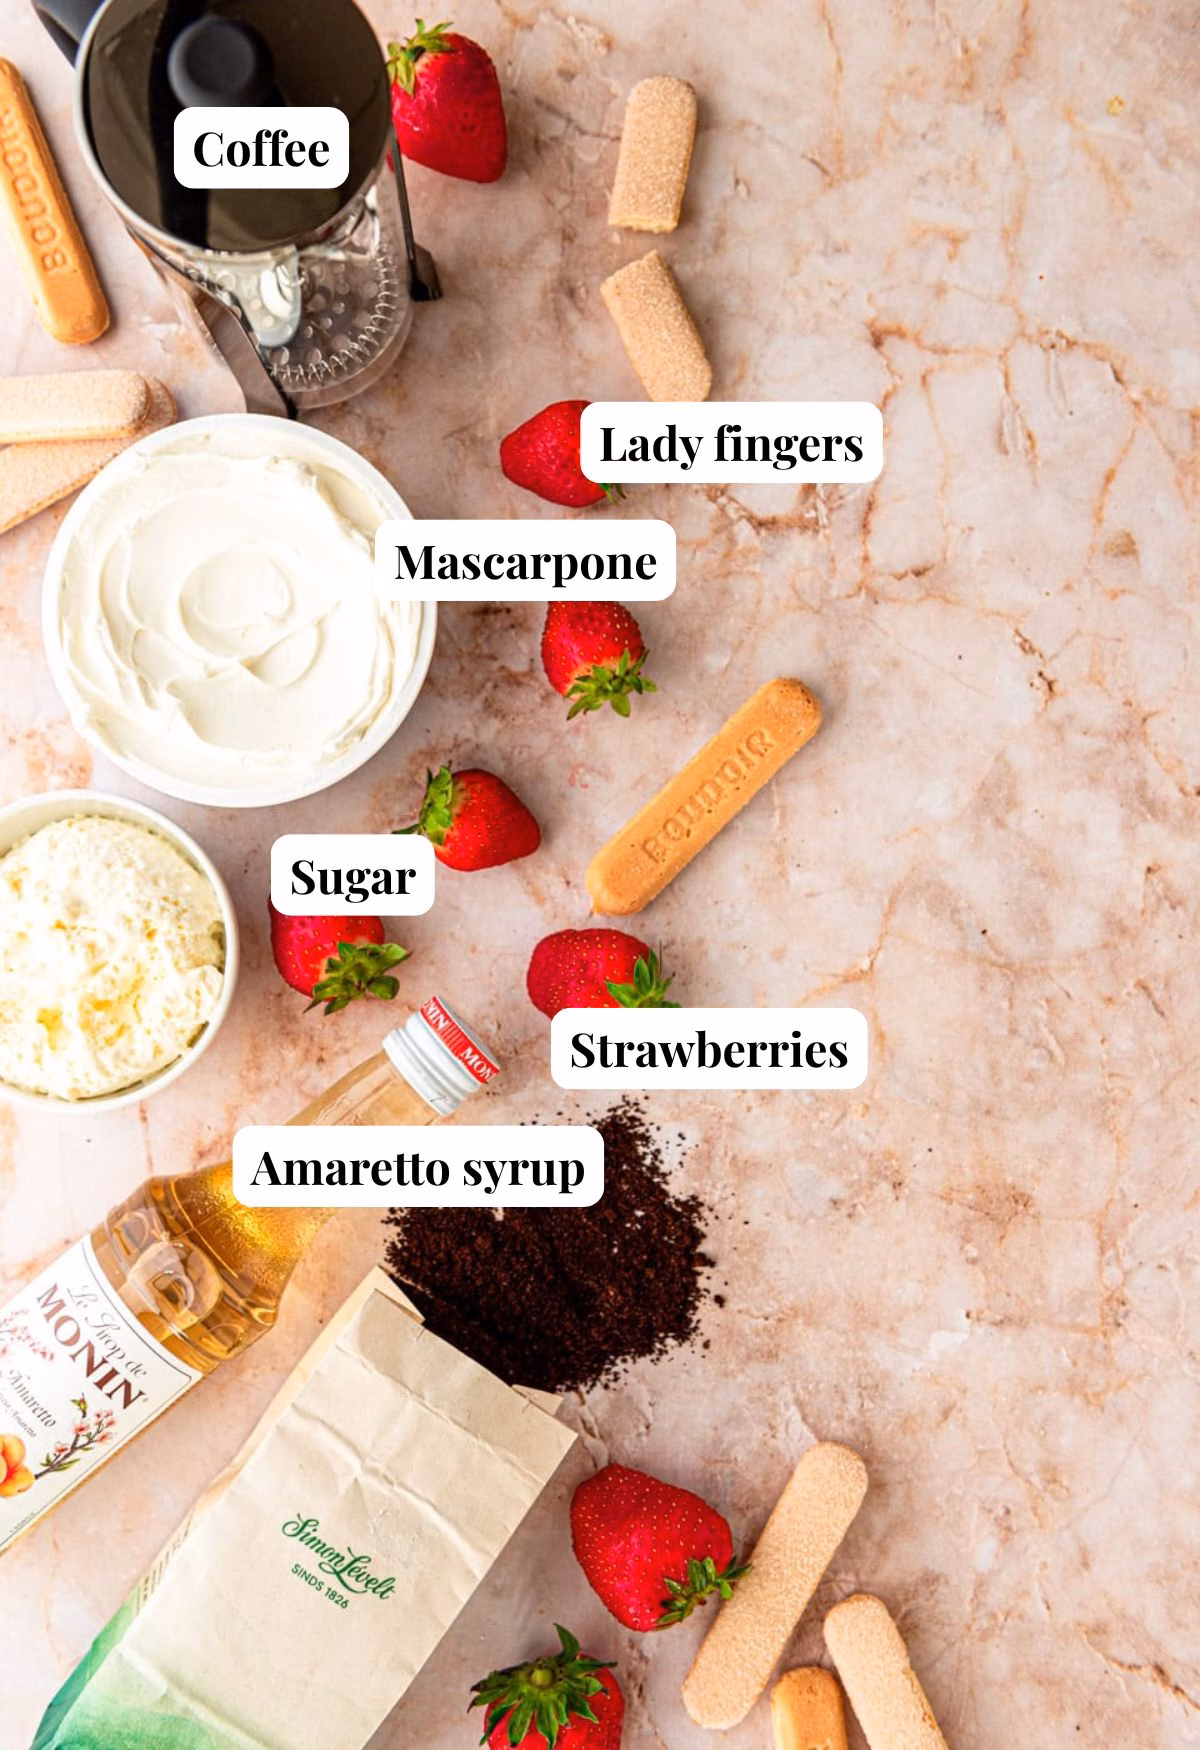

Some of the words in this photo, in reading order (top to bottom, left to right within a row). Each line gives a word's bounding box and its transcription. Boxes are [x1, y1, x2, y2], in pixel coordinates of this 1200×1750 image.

[640, 729, 774, 864] BOUDOIR
[424, 1000, 450, 1031] NIN
[36, 1283, 146, 1410] MONIN
[66, 1285, 98, 1309] Le
[84, 1312, 126, 1360] Sirop
[124, 1360, 147, 1377] de
[8, 1369, 57, 1428] Amaretto
[291, 1563, 325, 1591] SINDS
[324, 1587, 350, 1609] 1826
